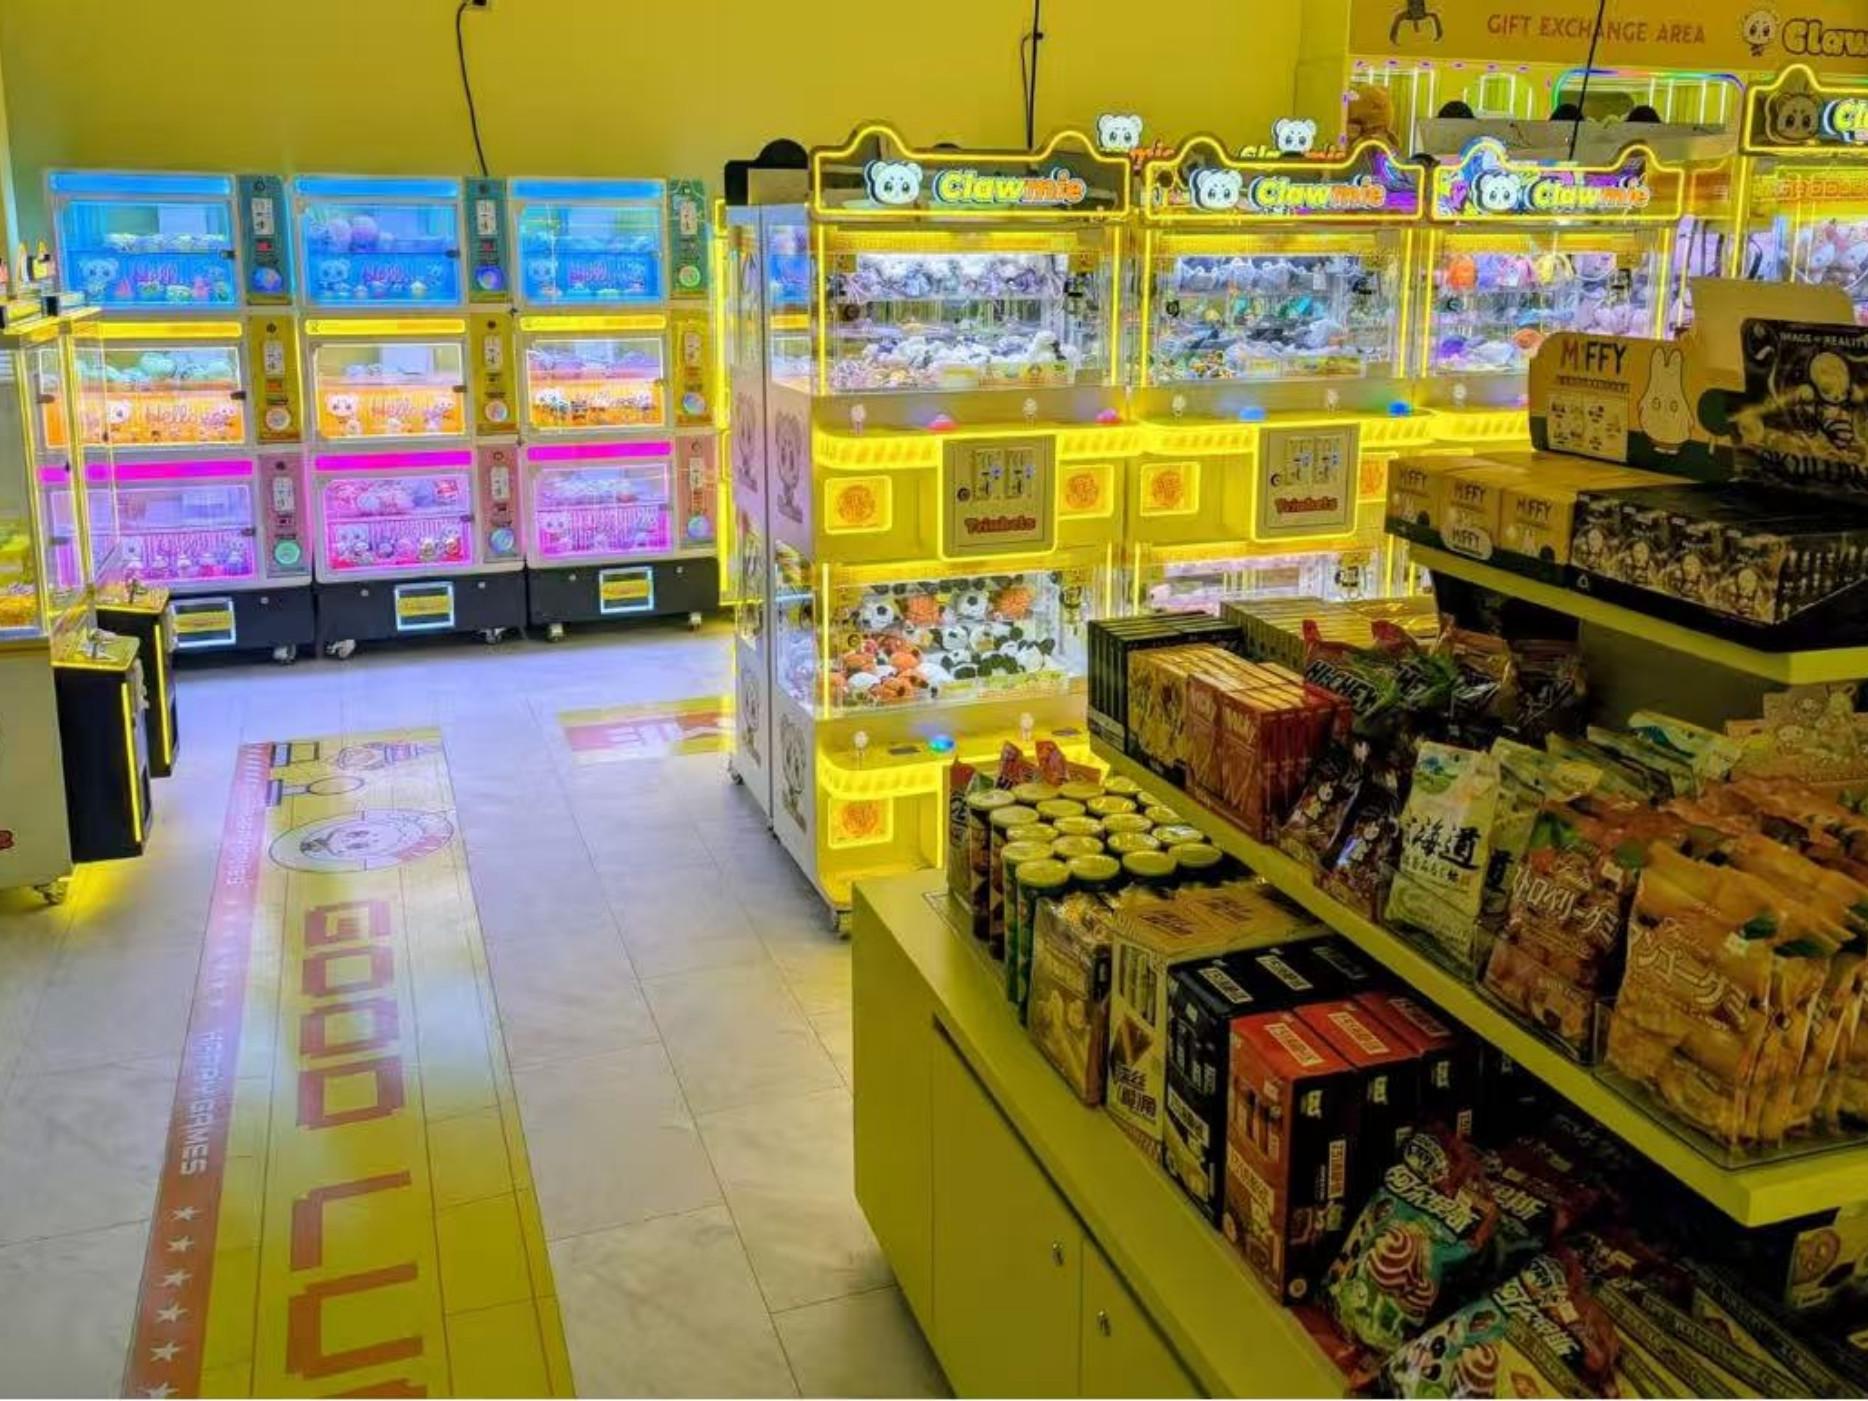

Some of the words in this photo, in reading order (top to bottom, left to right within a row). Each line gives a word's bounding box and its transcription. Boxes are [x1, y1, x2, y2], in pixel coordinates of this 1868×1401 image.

[1487, 14, 1532, 36] GIFT
[1539, 16, 1649, 43] EXCHANGE
[1656, 21, 1706, 44] AREA
[936, 168, 1087, 204] Clawmie
[1254, 175, 1386, 208] Clawmie
[1531, 174, 1651, 208] Clawmie
[1560, 339, 1628, 375] MFFY
[294, 900, 404, 1130] GOOD
[180, 1098, 217, 1176] GAMES
[285, 1168, 428, 1399] LU
